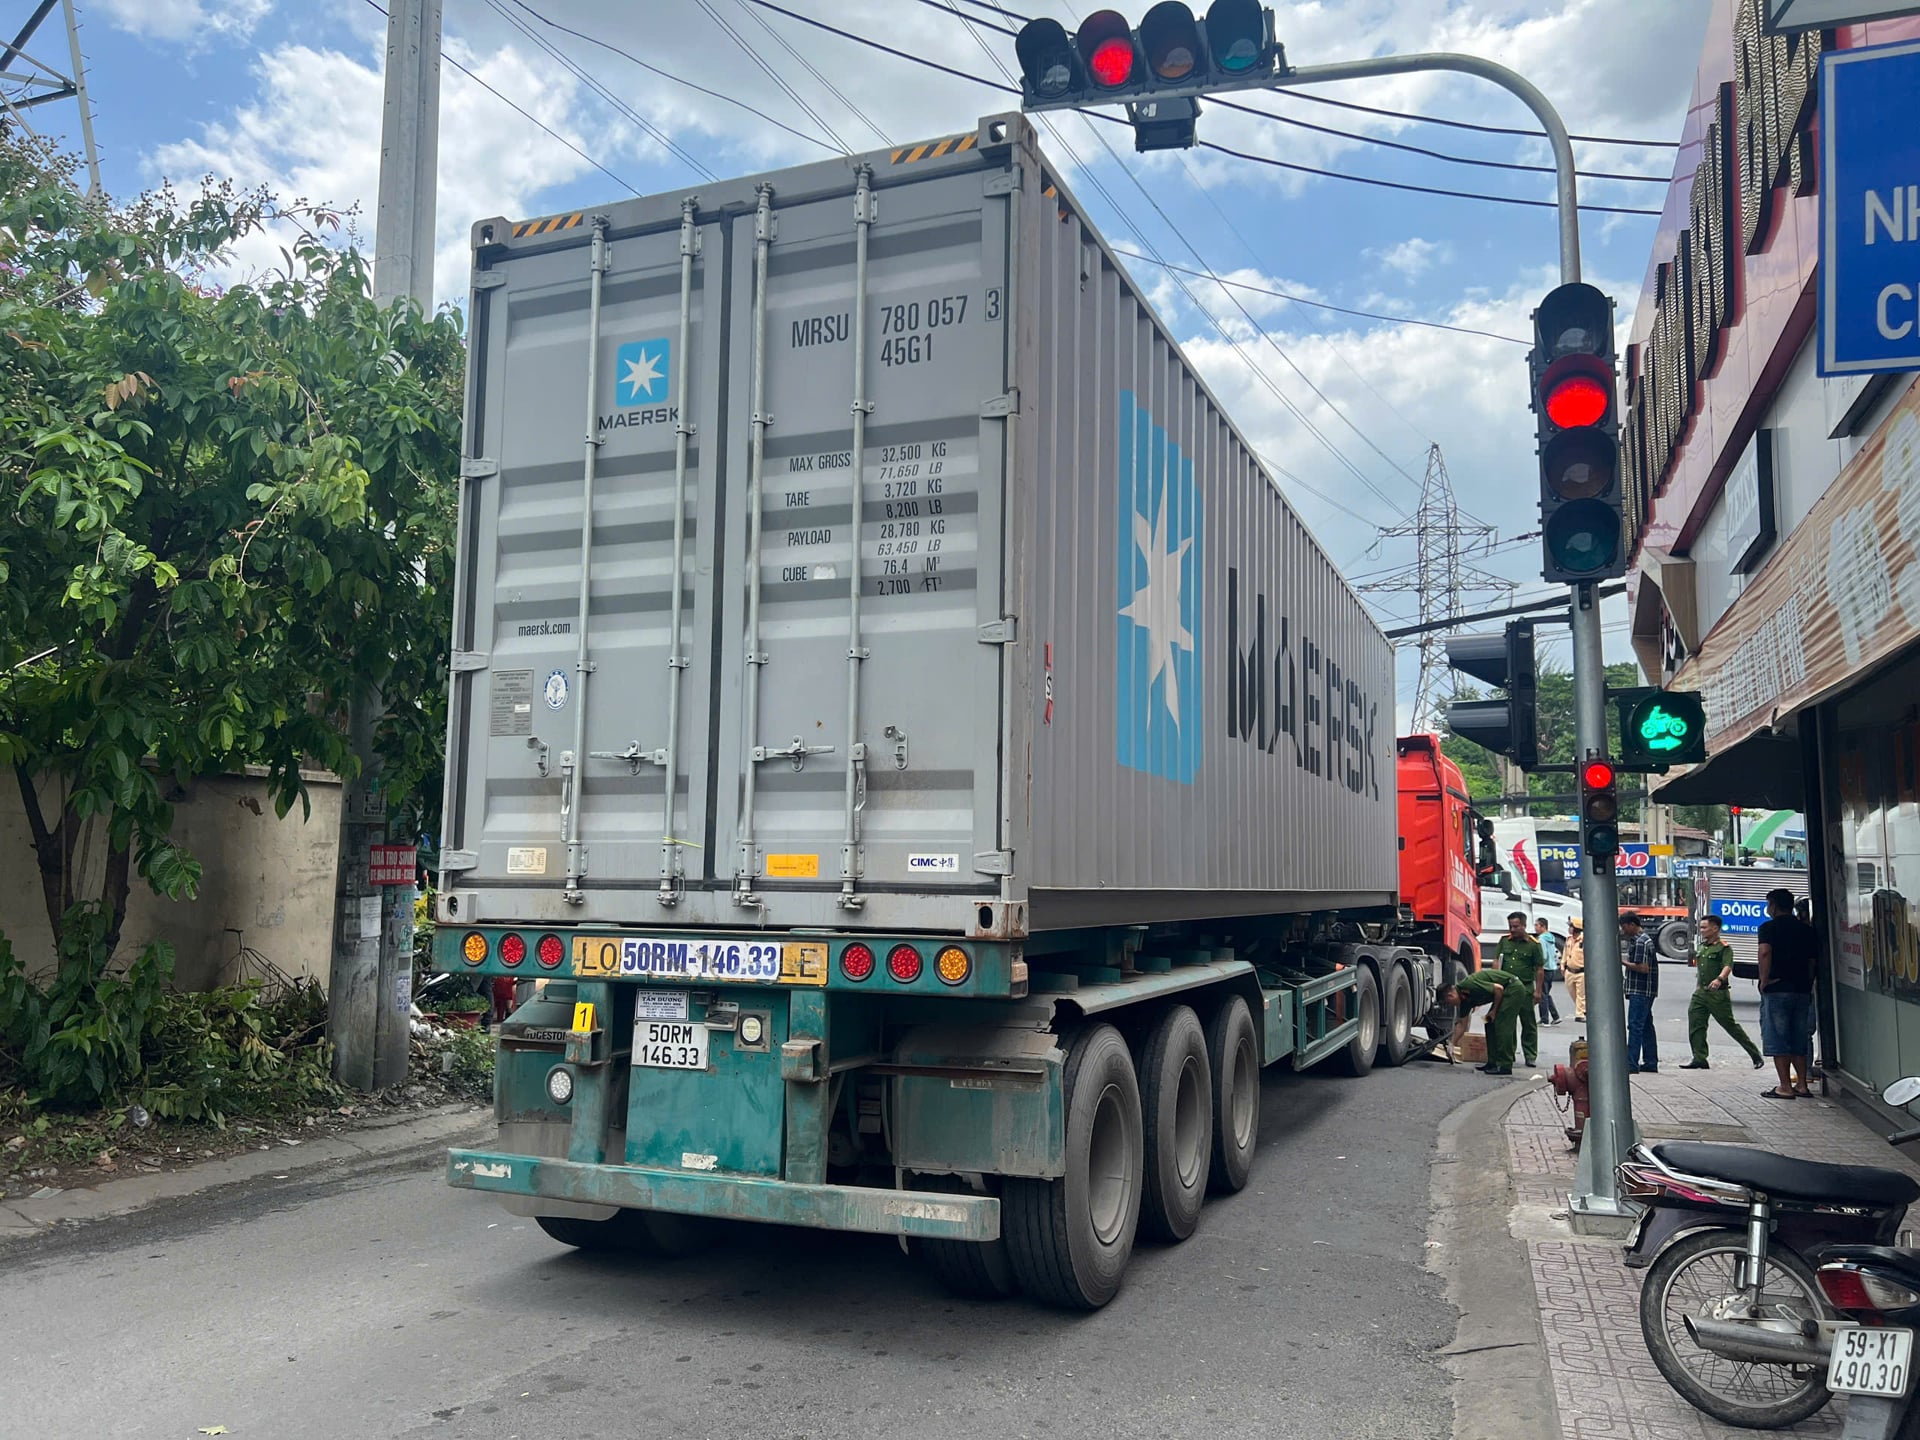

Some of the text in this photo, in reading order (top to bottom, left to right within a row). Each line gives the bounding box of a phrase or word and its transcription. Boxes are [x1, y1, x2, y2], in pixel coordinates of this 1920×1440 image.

[791, 289, 1000, 349] MRSU 780 057 3
[1876, 282, 1920, 341] C
[881, 333, 932, 367] 45G1
[598, 407, 679, 431] MAERSK
[789, 441, 946, 472] MAX GROSS 32,500 KG
[929, 462, 943, 475] LB
[785, 478, 942, 507] TARE 3,720 KG
[928, 499, 942, 515] LB
[788, 529, 831, 547] PAYLOAD
[930, 519, 945, 535] KG
[927, 539, 941, 552] LB
[782, 566, 807, 582] CUBE
[883, 558, 908, 575] 76.4
[518, 620, 571, 637] maersk.com
[1228, 567, 1379, 802] MAERSK
[910, 858, 938, 867] CIMC
[1540, 847, 1577, 860] Phê
[1721, 901, 1761, 917] ĐÔNG
[623, 942, 777, 976] 50RM-146.33
[579, 1007, 587, 1028] 1
[649, 1024, 693, 1044] 50RM
[642, 1044, 699, 1066] 146.33
[1845, 1331, 1897, 1360] 59-X1
[1834, 1360, 1902, 1391] 490.30
